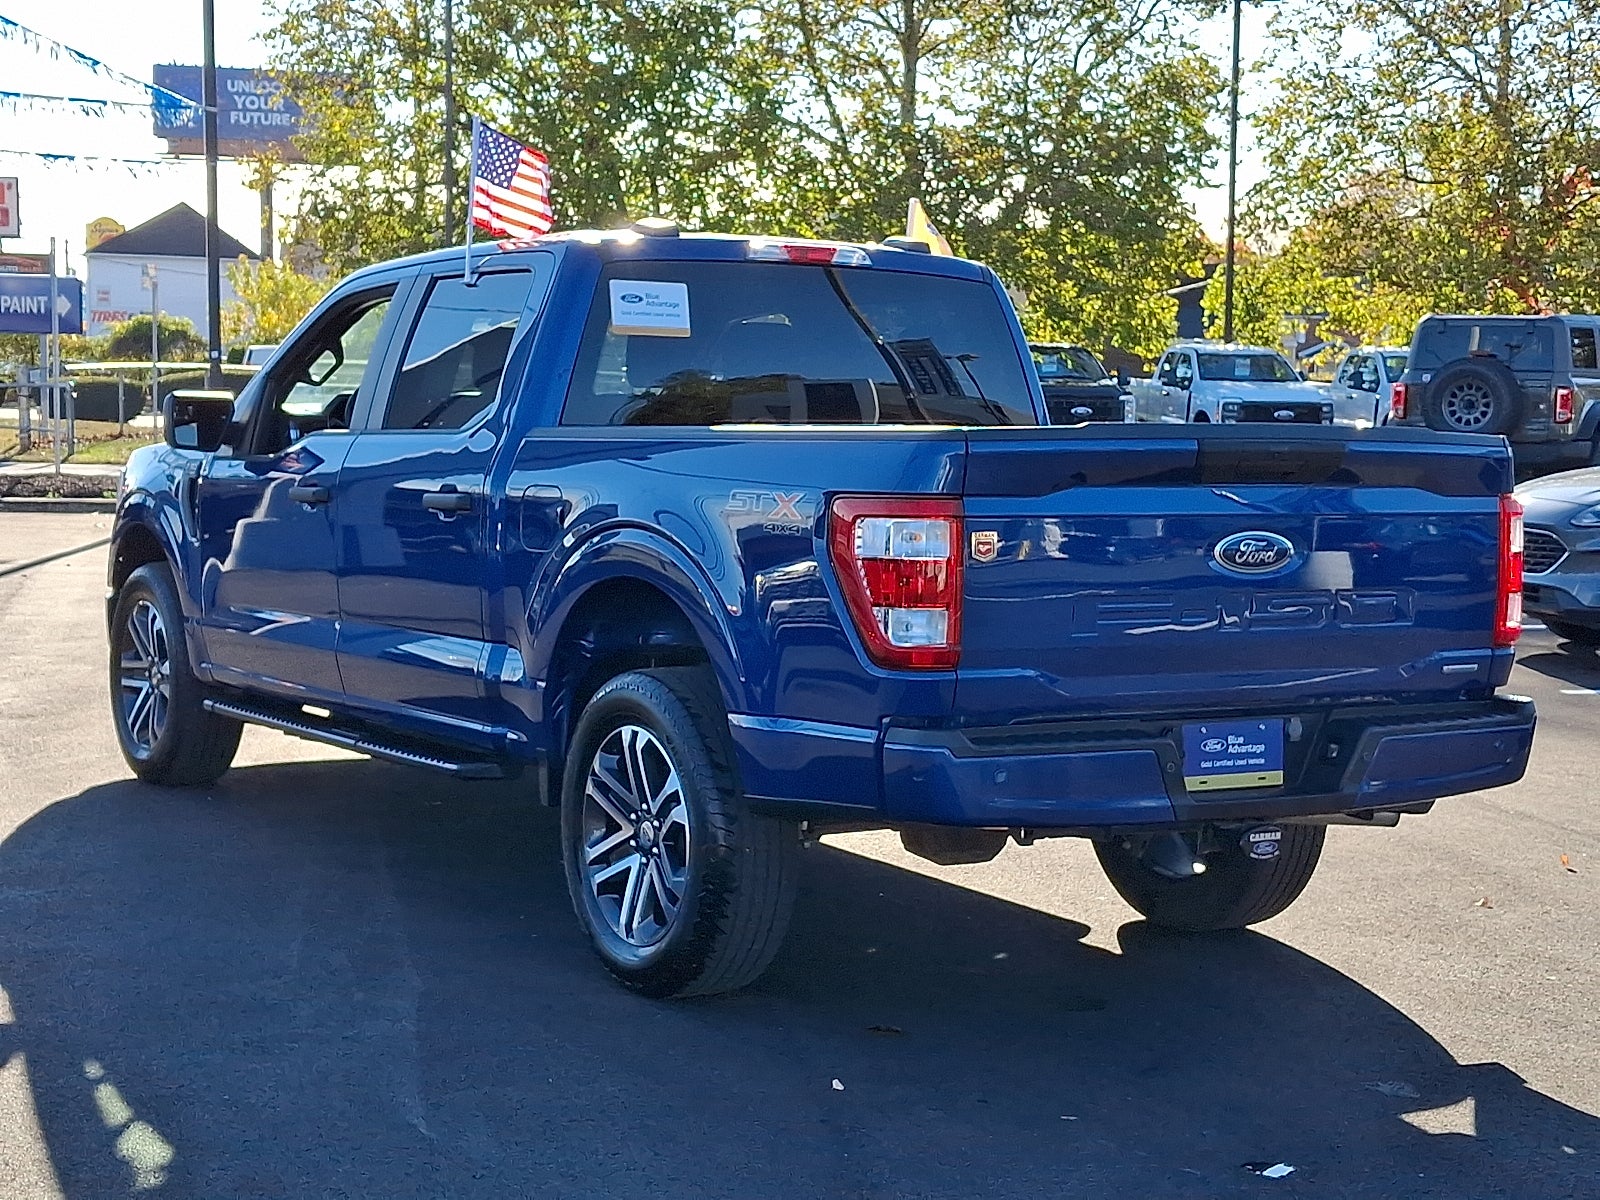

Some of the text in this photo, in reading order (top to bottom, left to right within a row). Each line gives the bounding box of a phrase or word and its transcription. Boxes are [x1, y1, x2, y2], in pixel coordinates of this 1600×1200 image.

[233, 95, 285, 111] YOUR
[230, 111, 291, 126] FUTURE
[0, 295, 48, 314] PAINT
[726, 490, 805, 519] STX
[1235, 539, 1278, 563] Ford
[1228, 736, 1244, 744] Blue
[1228, 744, 1265, 753] Advantage
